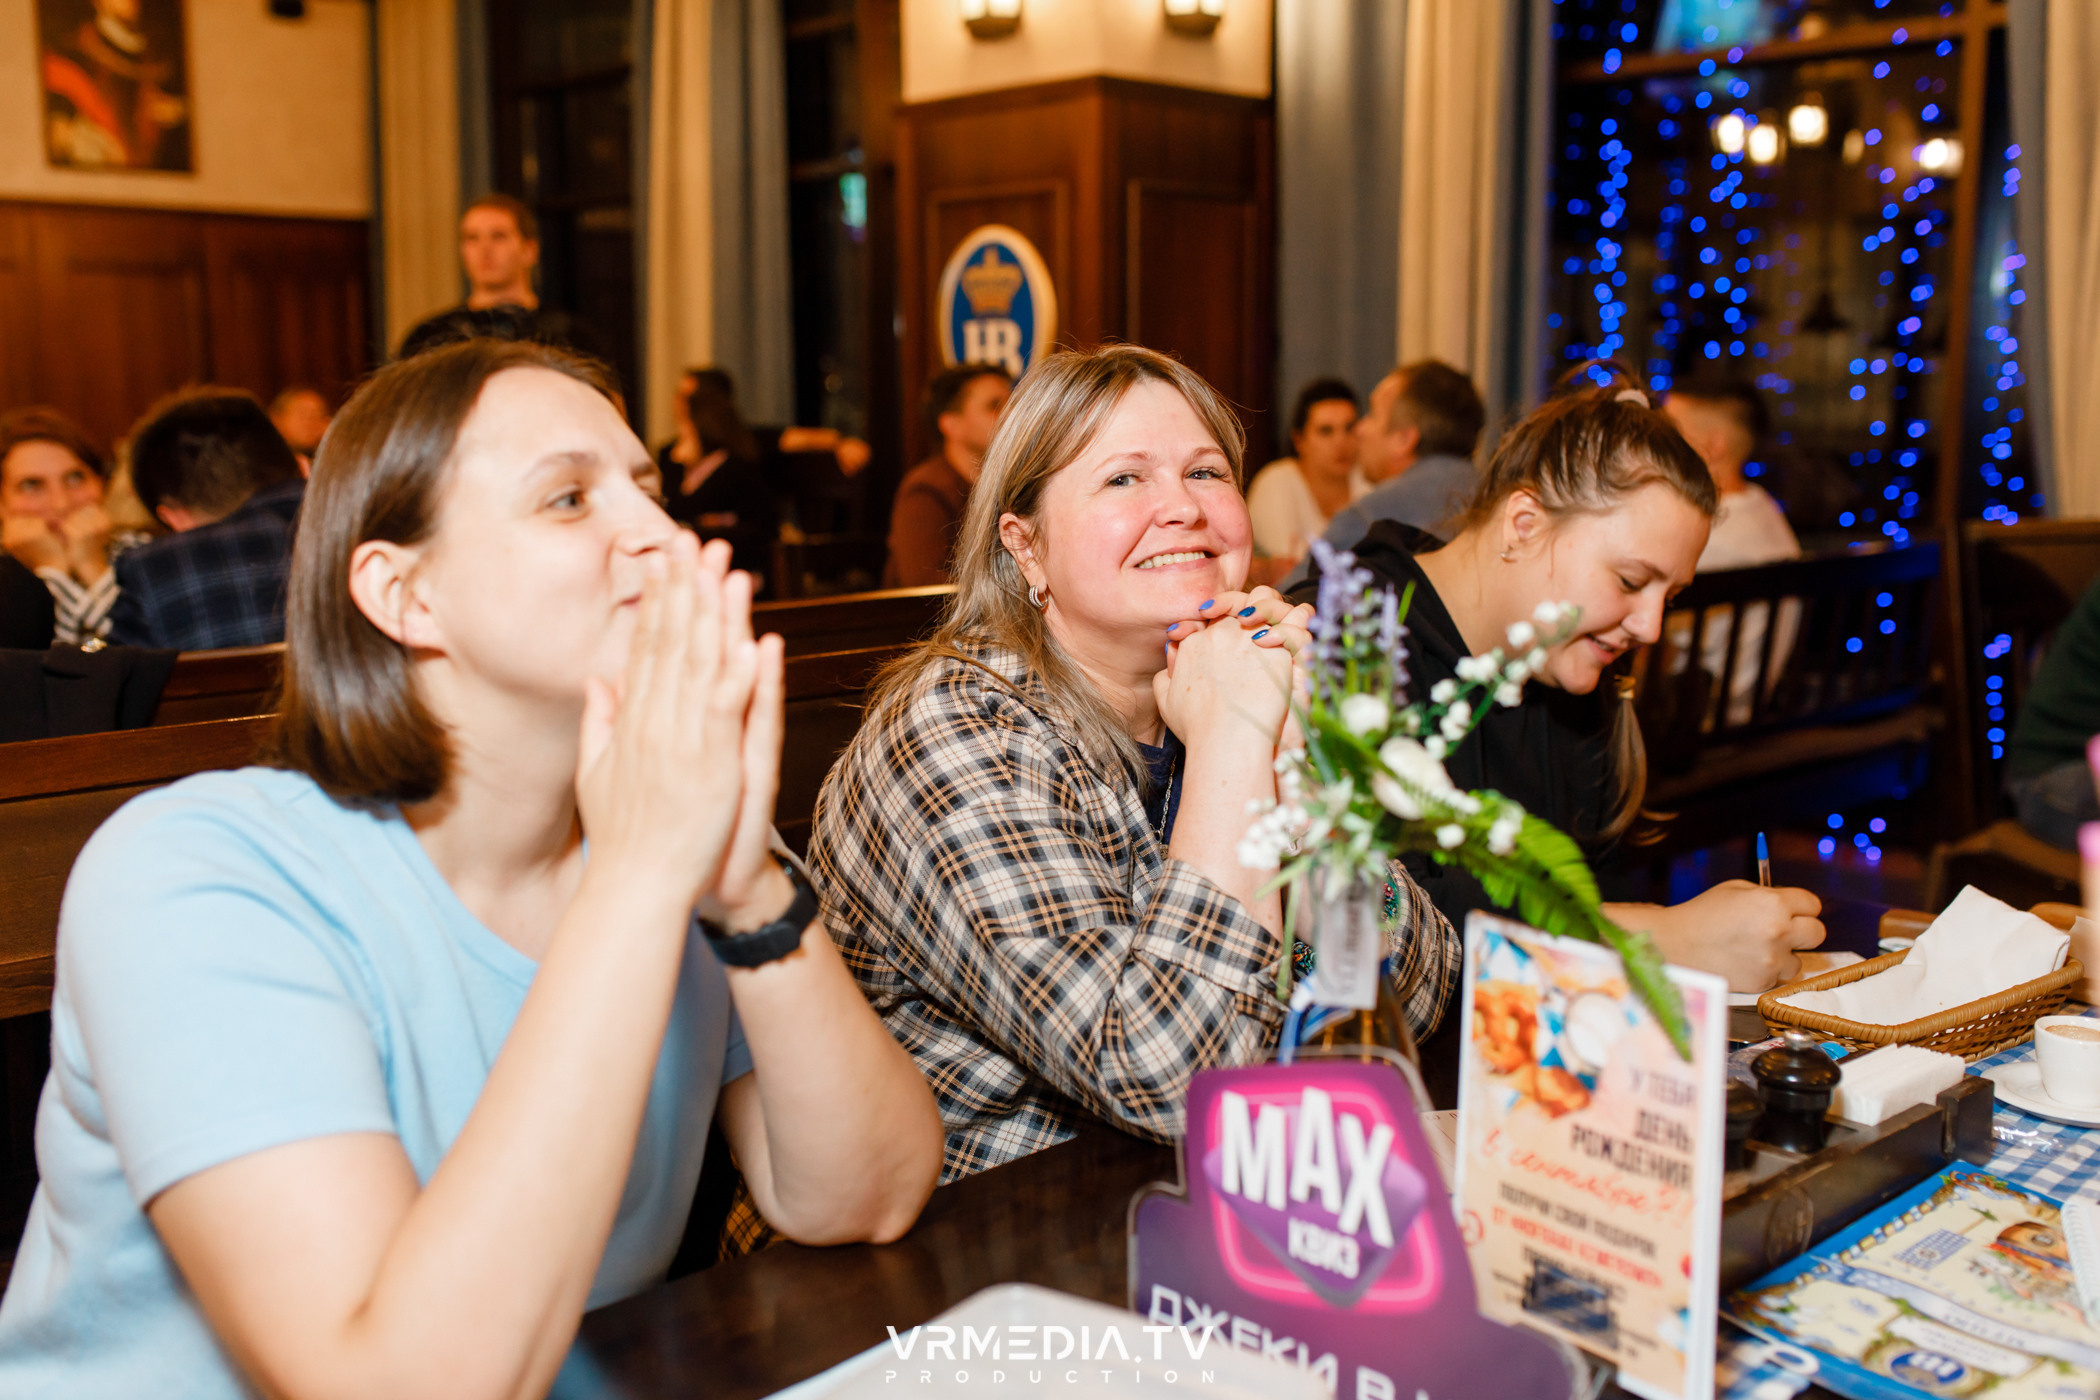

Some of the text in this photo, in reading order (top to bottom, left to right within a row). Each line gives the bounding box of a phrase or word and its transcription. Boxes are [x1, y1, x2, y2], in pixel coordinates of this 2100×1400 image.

[1570, 1122, 1692, 1190] РОЖДЕНИЯ
[1633, 1107, 1692, 1152] ДЕНЬ
[1221, 1085, 1395, 1249] MAX
[1288, 1216, 1360, 1279] КВИЗ
